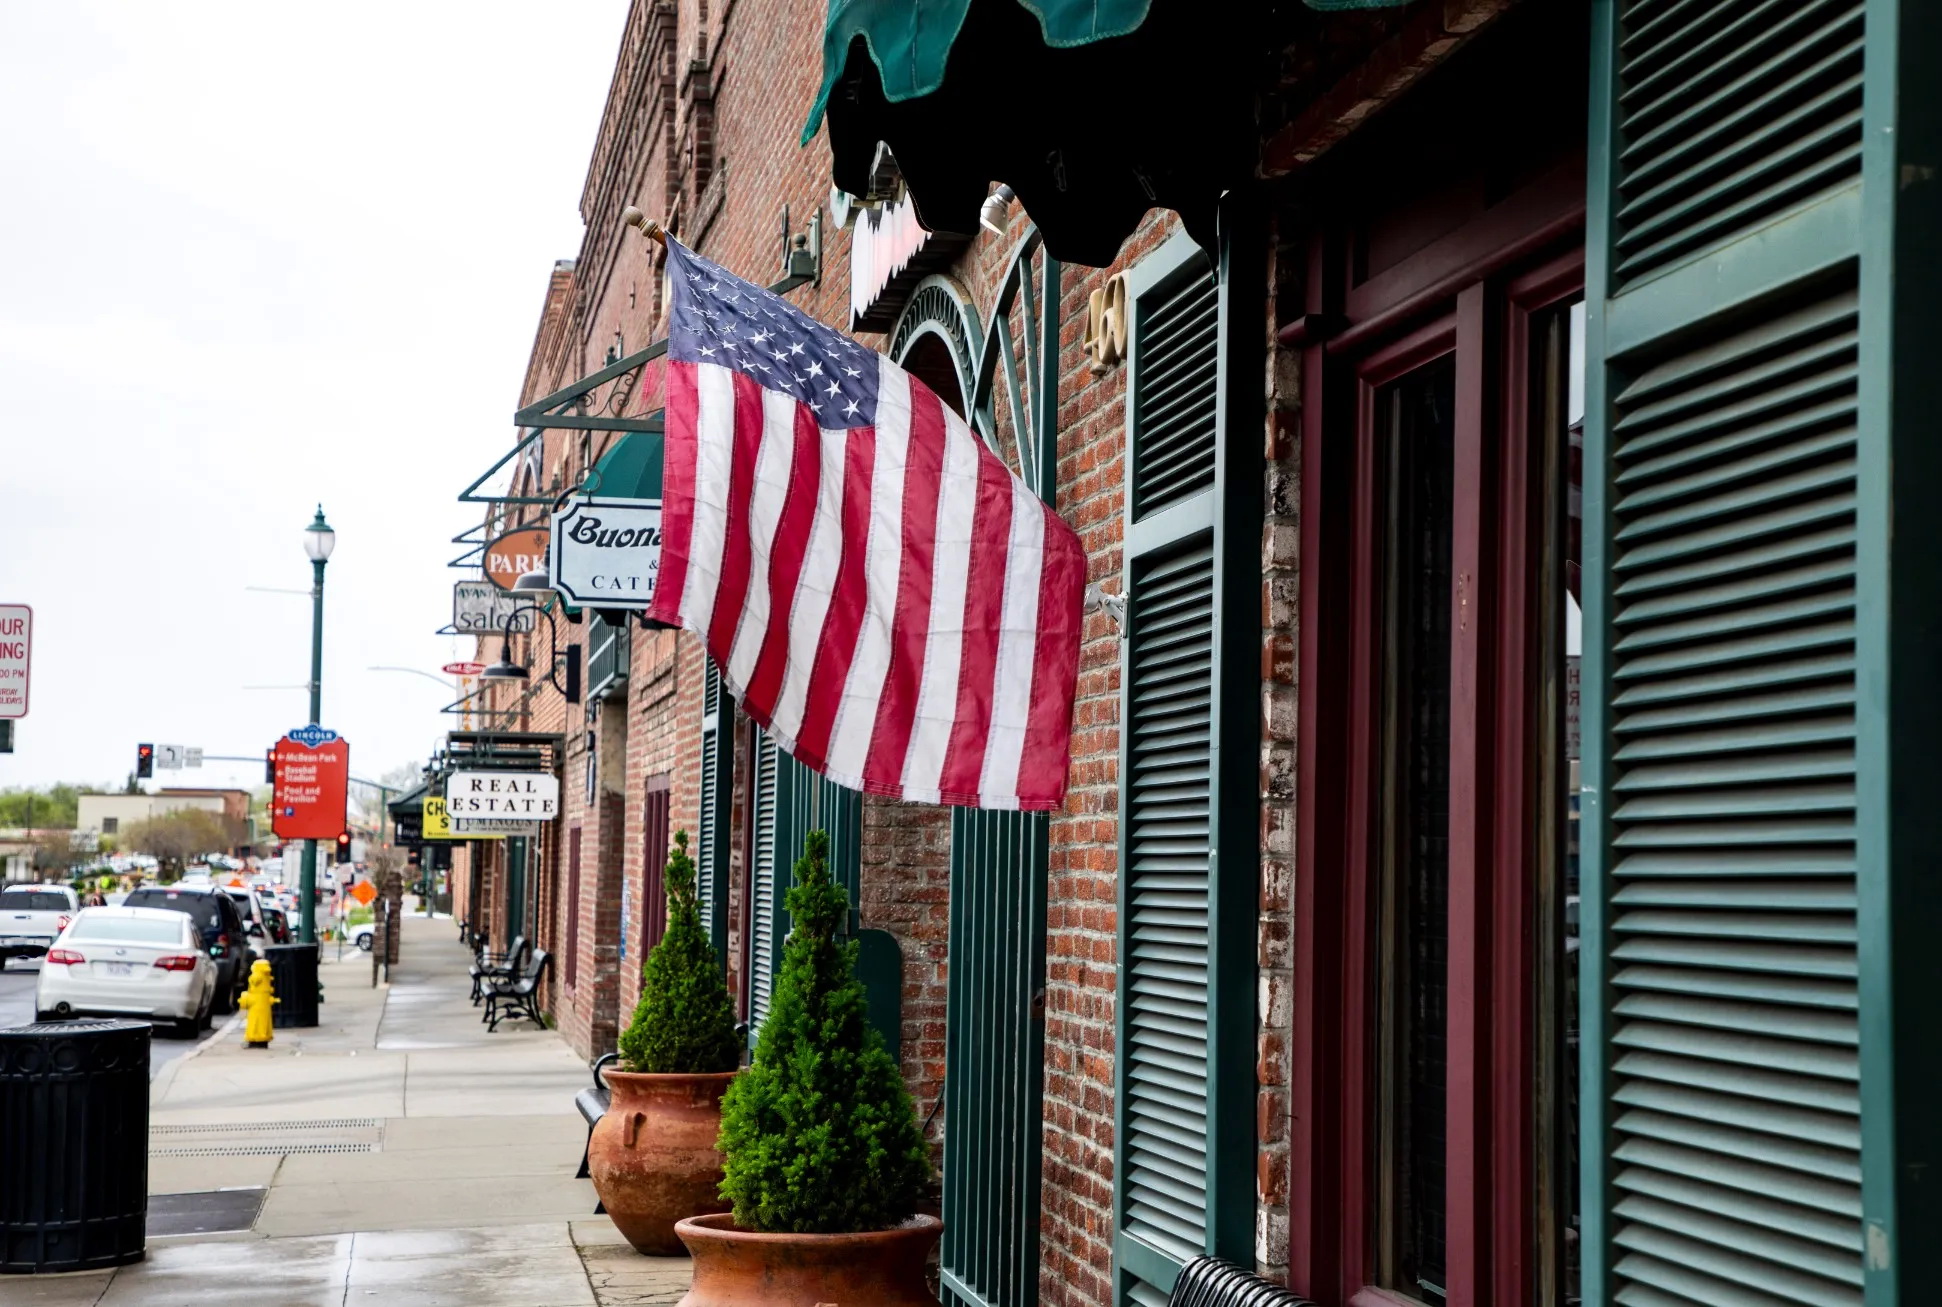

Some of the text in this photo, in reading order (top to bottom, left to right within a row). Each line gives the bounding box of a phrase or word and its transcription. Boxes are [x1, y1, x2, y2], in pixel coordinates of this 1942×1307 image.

[460, 607, 529, 630] salon
[0, 618, 24, 636] UR
[0, 687, 18, 696] RDAY
[292, 731, 333, 740] LINCOLN
[319, 753, 337, 763] Park
[284, 765, 317, 774] Baseball
[284, 774, 316, 782] Stadium
[470, 778, 537, 793] REAL
[283, 786, 321, 796] Pool and
[283, 794, 317, 803] Pavilion
[426, 802, 447, 816] CH
[452, 797, 553, 813] ESTATE
